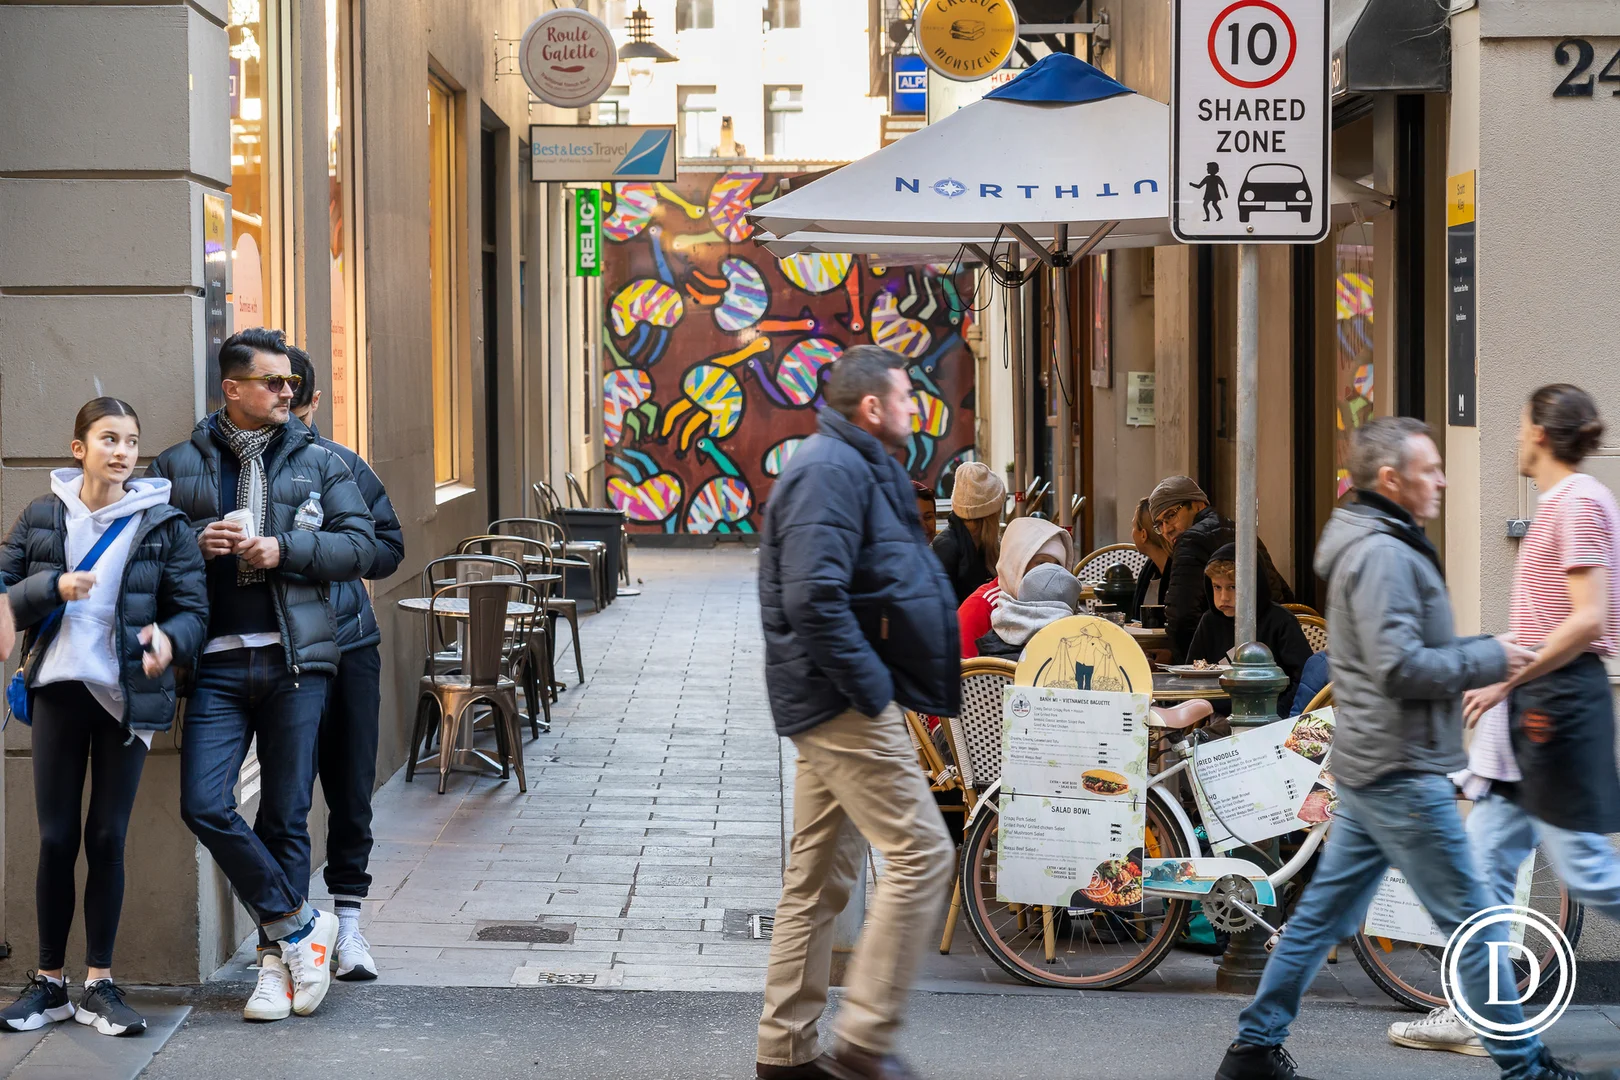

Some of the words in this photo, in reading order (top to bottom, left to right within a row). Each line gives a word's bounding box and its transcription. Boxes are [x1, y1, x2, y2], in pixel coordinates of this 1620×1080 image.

[546, 26, 592, 42] Roule
[1228, 22, 1277, 66] 10
[542, 44, 599, 62] Galette
[934, 46, 1000, 71] MONSIEUR
[1198, 98, 1306, 122] SHARED
[594, 142, 628, 156] Travel
[1216, 130, 1286, 153] ZONE
[580, 202, 596, 268] RELIC
[1213, 750, 1240, 762] NOODLES
[1051, 806, 1071, 814] SALAD
[1073, 807, 1091, 815] BOWL
